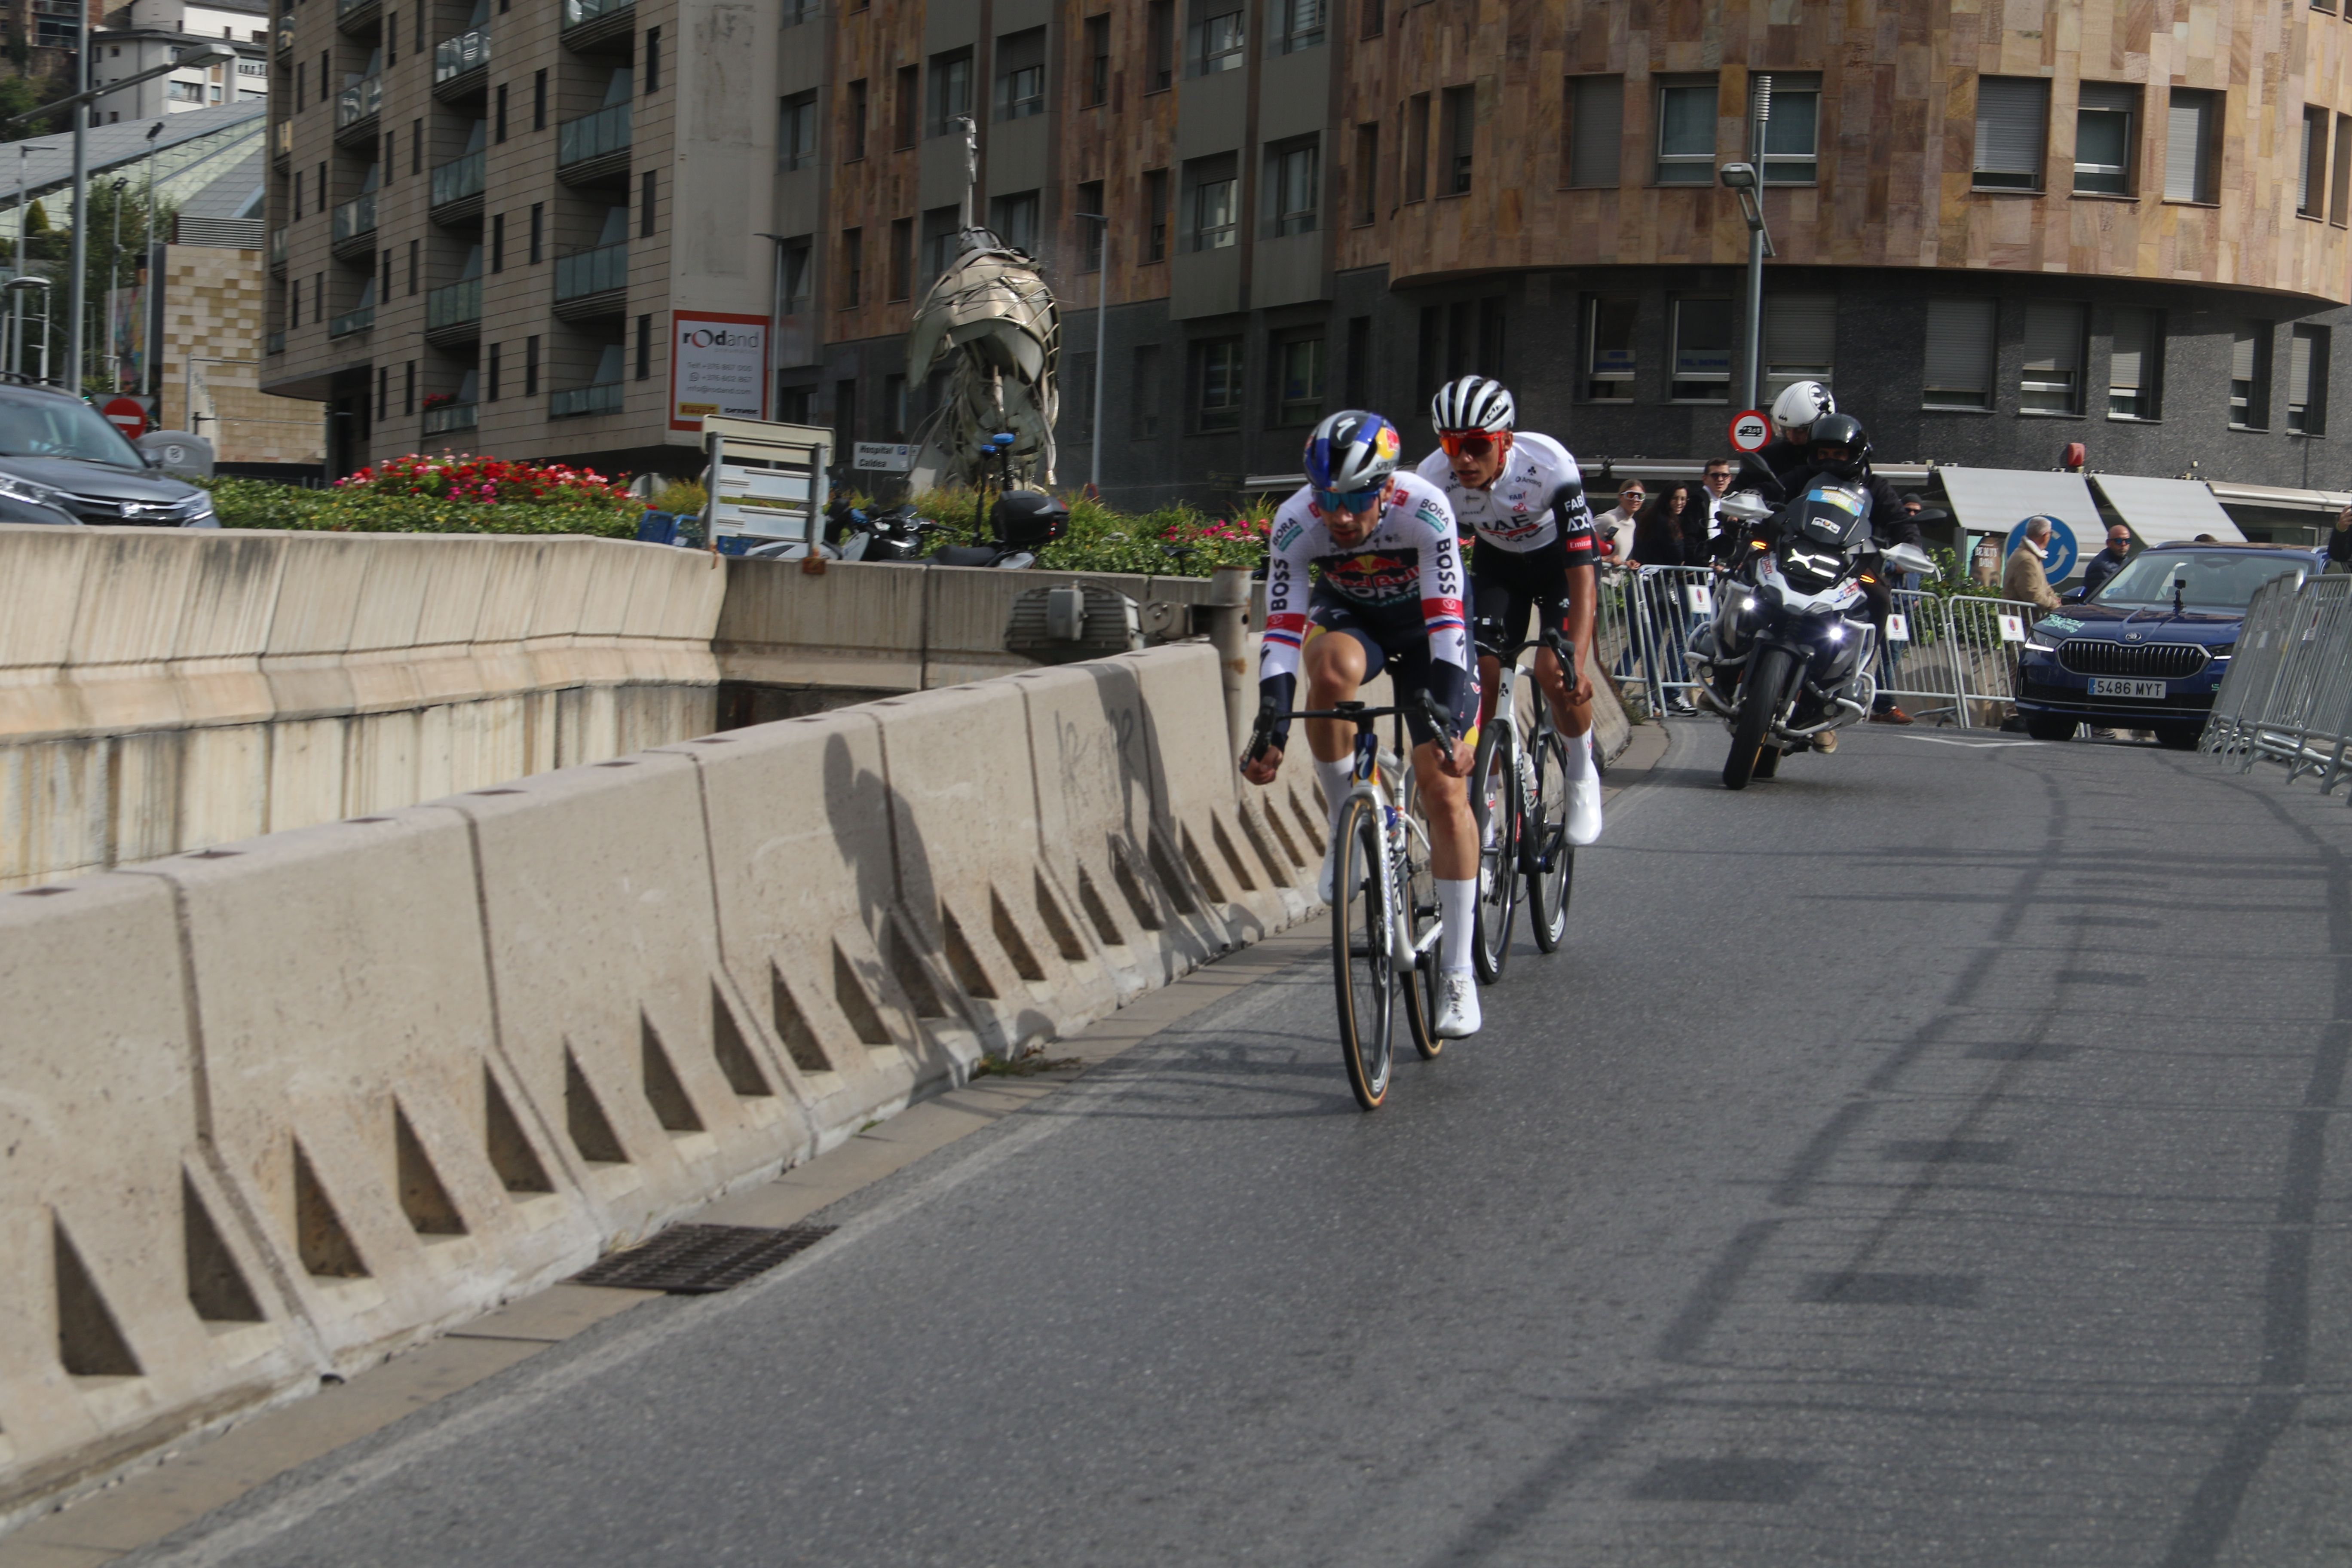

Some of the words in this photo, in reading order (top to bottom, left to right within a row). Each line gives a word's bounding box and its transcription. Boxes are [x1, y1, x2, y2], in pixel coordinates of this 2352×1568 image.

[859, 459, 887, 468] Caldea
[860, 444, 894, 456] Hospital
[1420, 499, 1449, 527] BORA
[1272, 518, 1297, 545] BORA
[1325, 572, 1372, 588] Red
[1373, 565, 1420, 587] Bull
[1436, 538, 1457, 595] BOSS
[1271, 559, 1290, 611] BOSS
[2097, 681, 2131, 695] 5486
[2136, 683, 2162, 696] MYT
[1518, 747, 1530, 818] LNAGO
